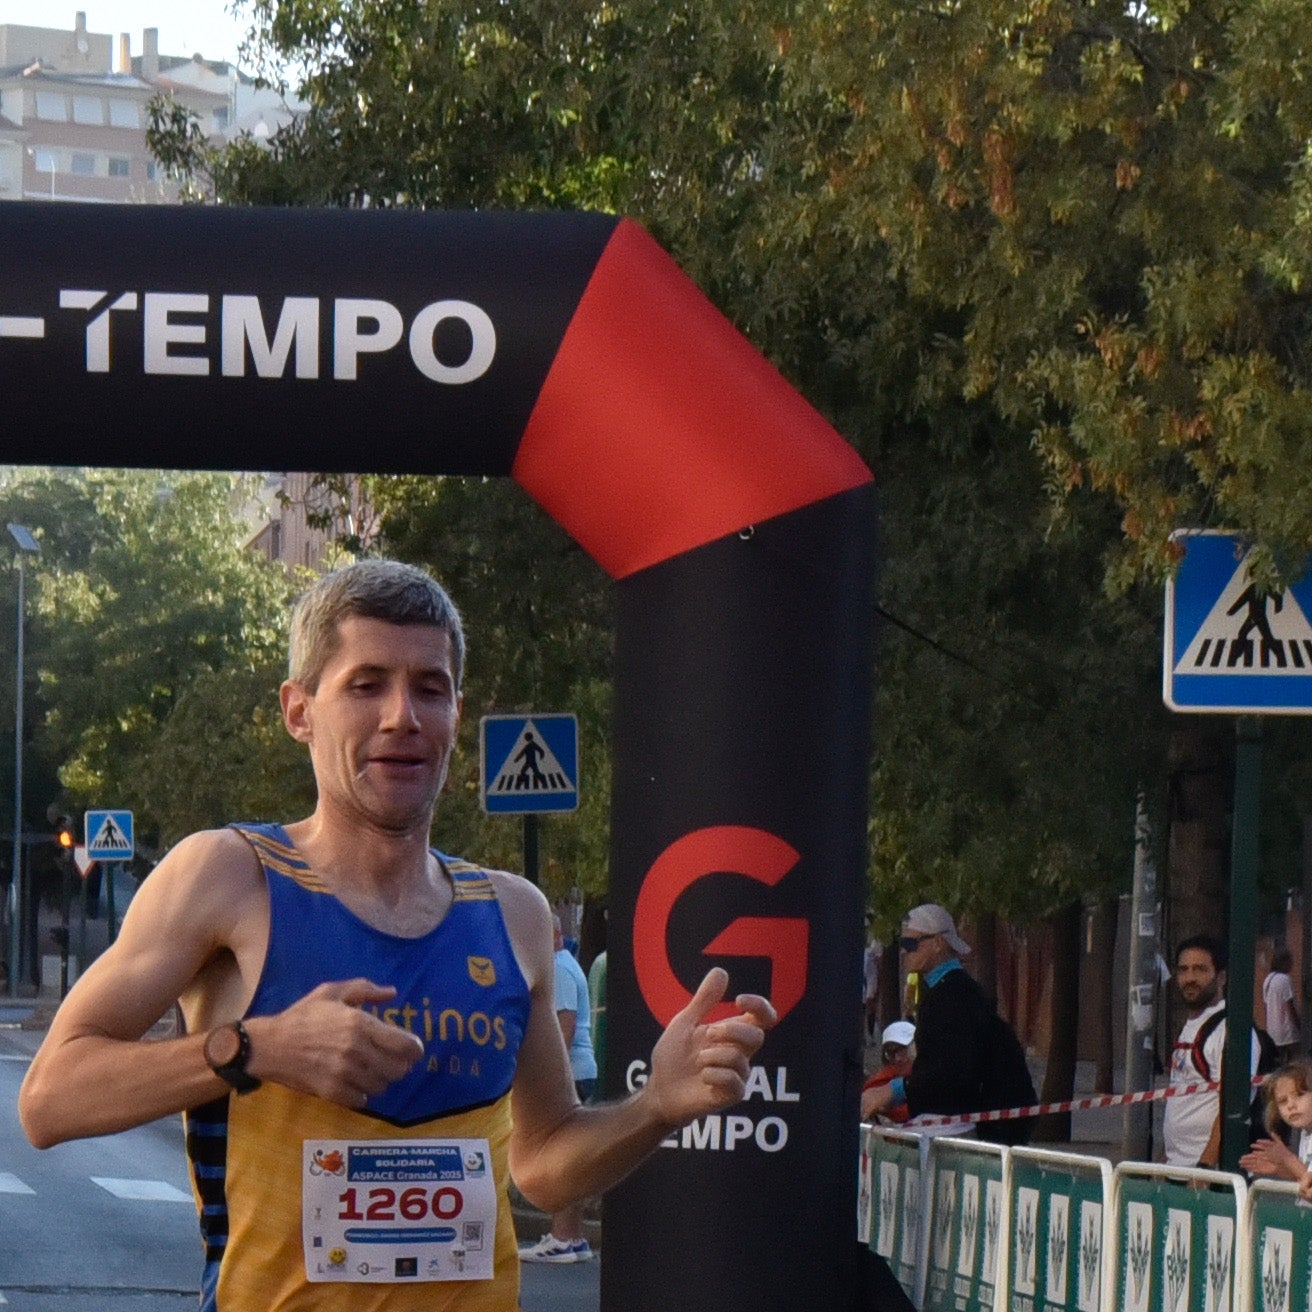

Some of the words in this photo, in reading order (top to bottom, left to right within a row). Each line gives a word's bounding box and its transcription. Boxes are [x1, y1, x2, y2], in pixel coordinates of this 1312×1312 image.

[626, 1059, 800, 1102] GAL
[352, 1171, 394, 1181] ASPACE
[396, 1171, 438, 1180] Granada
[338, 1187, 463, 1221] 1260
